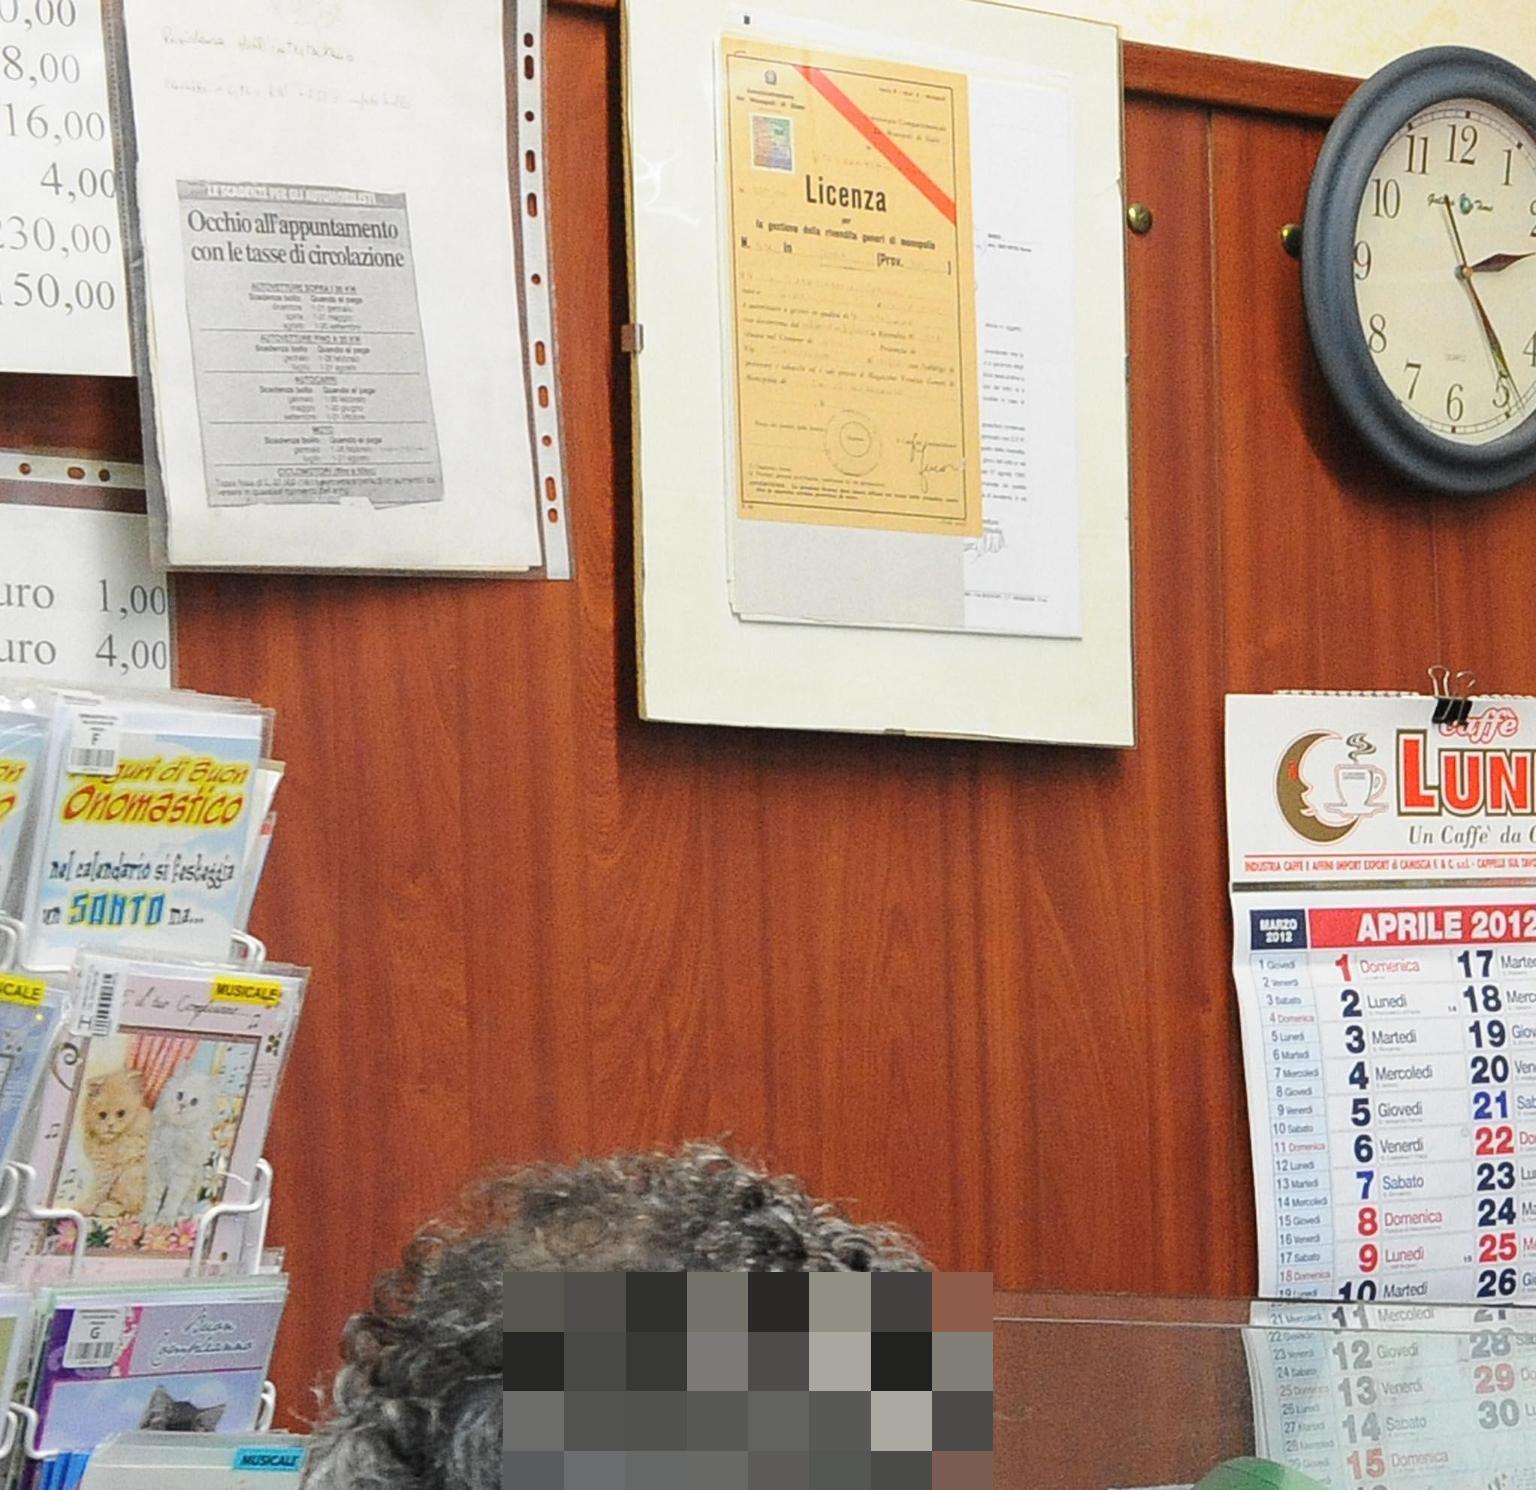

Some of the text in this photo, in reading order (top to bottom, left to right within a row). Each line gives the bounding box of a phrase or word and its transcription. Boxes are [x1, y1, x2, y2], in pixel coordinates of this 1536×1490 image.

[4, 103, 105, 145] 16,00
[1403, 133, 1430, 176] 11
[1446, 123, 1478, 166] 12
[40, 162, 115, 203] 4,00
[1501, 148, 1514, 187] 1
[805, 174, 887, 212] Licenza
[1370, 178, 1402, 219] 10
[187, 209, 399, 242] Occhio all'appuntamento
[191, 241, 405, 268] con le tasse di circolazione
[1353, 240, 1373, 281] 9
[1368, 313, 1387, 354] 8
[1403, 361, 1422, 400] 7
[1492, 371, 1511, 409] 5
[1445, 383, 1464, 422] 6
[98, 579, 167, 617] 1,00
[95, 634, 167, 673] 4,00
[188, 761, 248, 784] Buon
[63, 784, 244, 824] Onomastico
[1408, 825, 1434, 845] Un
[1440, 824, 1493, 849] Caffè
[1499, 824, 1523, 845] da
[1259, 918, 1298, 931] MARZO
[1265, 932, 1293, 944] 2012
[1357, 909, 1462, 941] APRILE
[1335, 953, 1420, 982] 1 Domenica
[1457, 949, 1493, 978] 17
[216, 983, 279, 1001] MUSICALE
[1340, 988, 1363, 1018] 2
[1468, 1019, 1506, 1048] 19
[1472, 1090, 1508, 1120] 21
[1355, 1170, 1424, 1200] 7 Sabato
